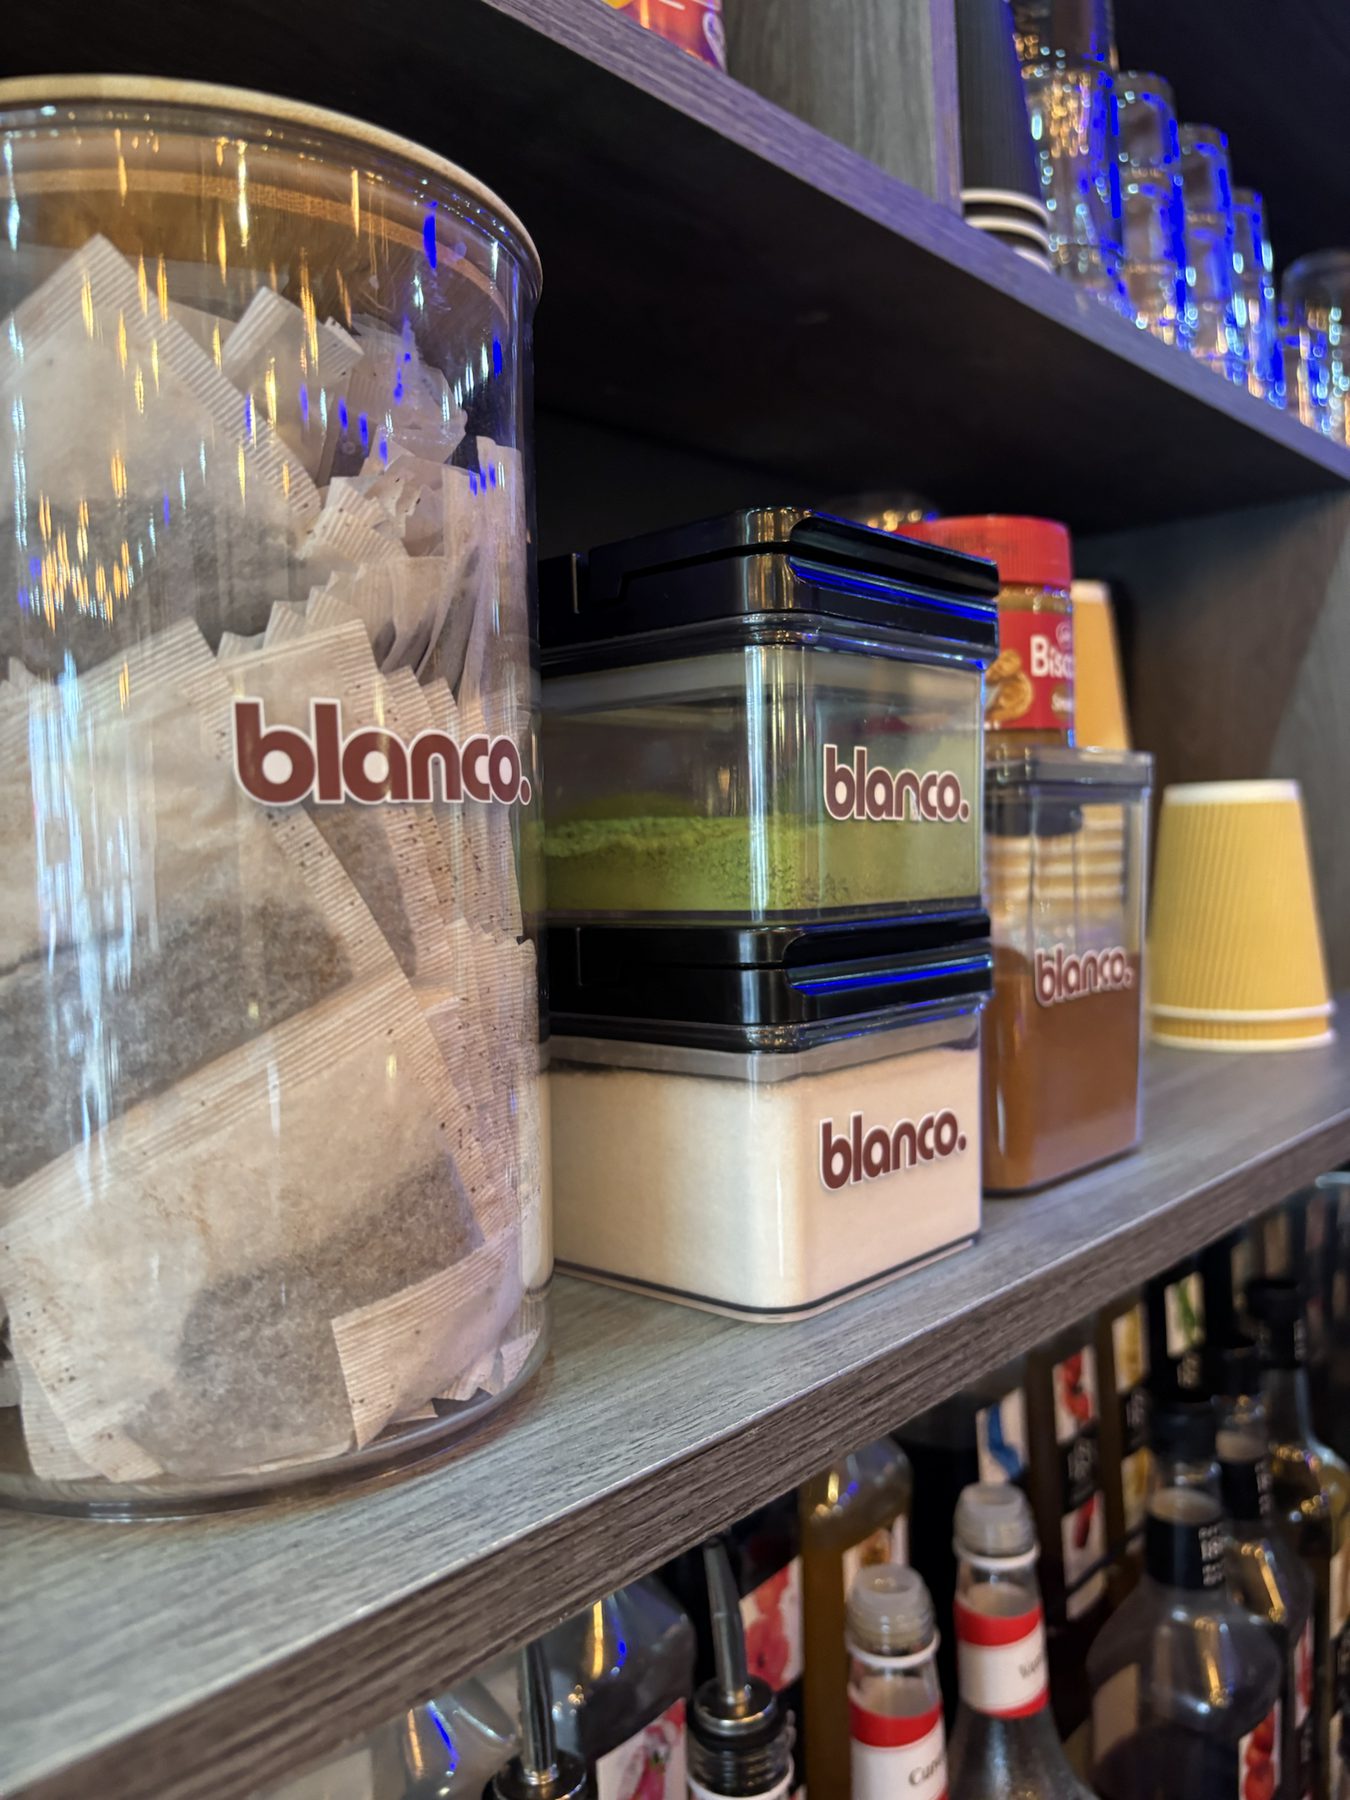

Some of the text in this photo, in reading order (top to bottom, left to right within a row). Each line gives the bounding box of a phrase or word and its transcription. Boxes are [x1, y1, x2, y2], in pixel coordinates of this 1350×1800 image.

[233, 698, 532, 806] blanco.
[823, 743, 969, 822] blanco.
[1034, 942, 1134, 1007] blanco.
[820, 1107, 967, 1189] blanco.
